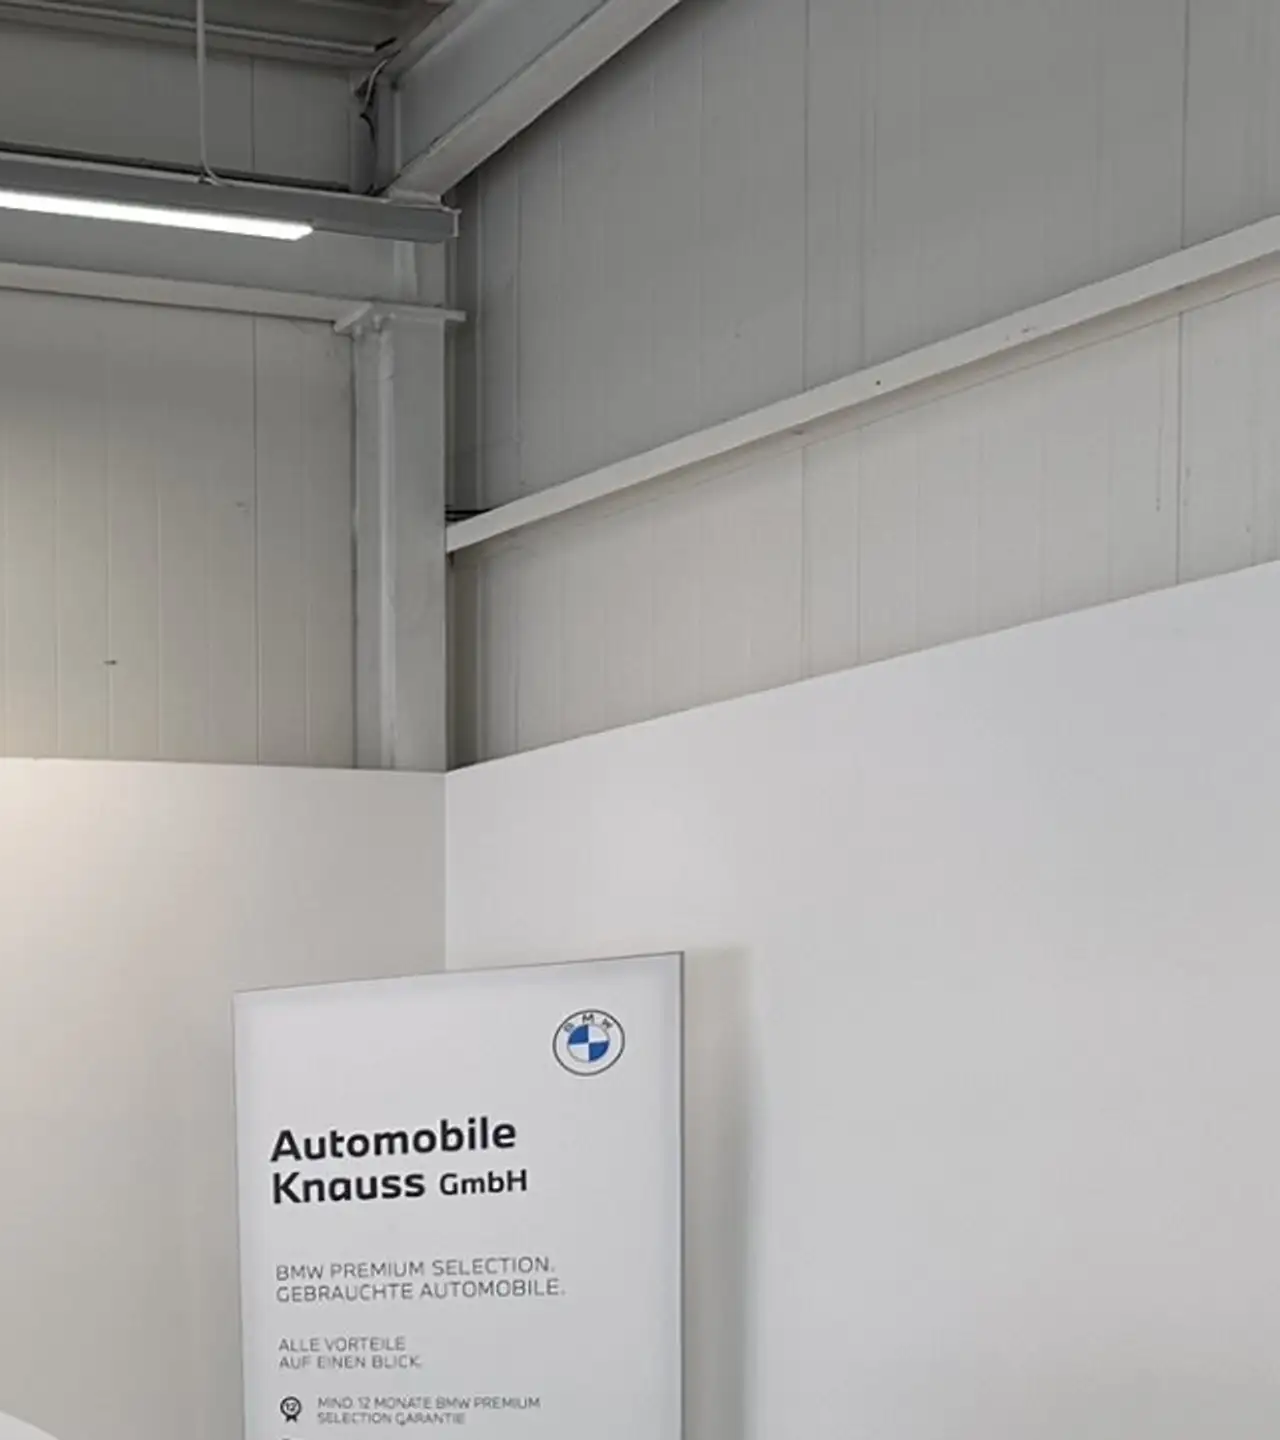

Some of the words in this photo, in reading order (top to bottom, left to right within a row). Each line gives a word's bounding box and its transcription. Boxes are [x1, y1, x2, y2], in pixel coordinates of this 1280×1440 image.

[271, 1117, 517, 1162] Automobile
[273, 1171, 425, 1204] Knauss
[439, 1169, 527, 1195] GmbH
[276, 1264, 323, 1281] BMW
[331, 1260, 424, 1279] PREMIUM
[432, 1256, 556, 1276] SELECTION.
[276, 1283, 413, 1303] GEBRAUCHTE
[420, 1278, 566, 1299] AUTOMOBILE.
[278, 1337, 320, 1352] ALLE
[324, 1336, 406, 1352] VORTEILE
[279, 1355, 311, 1370] AUF
[317, 1355, 366, 1370] EINEN
[374, 1396, 432, 1410] MONATE
[436, 1396, 470, 1410] BMW
[474, 1396, 541, 1410] PREMIUM
[318, 1412, 392, 1425] SELECTION
